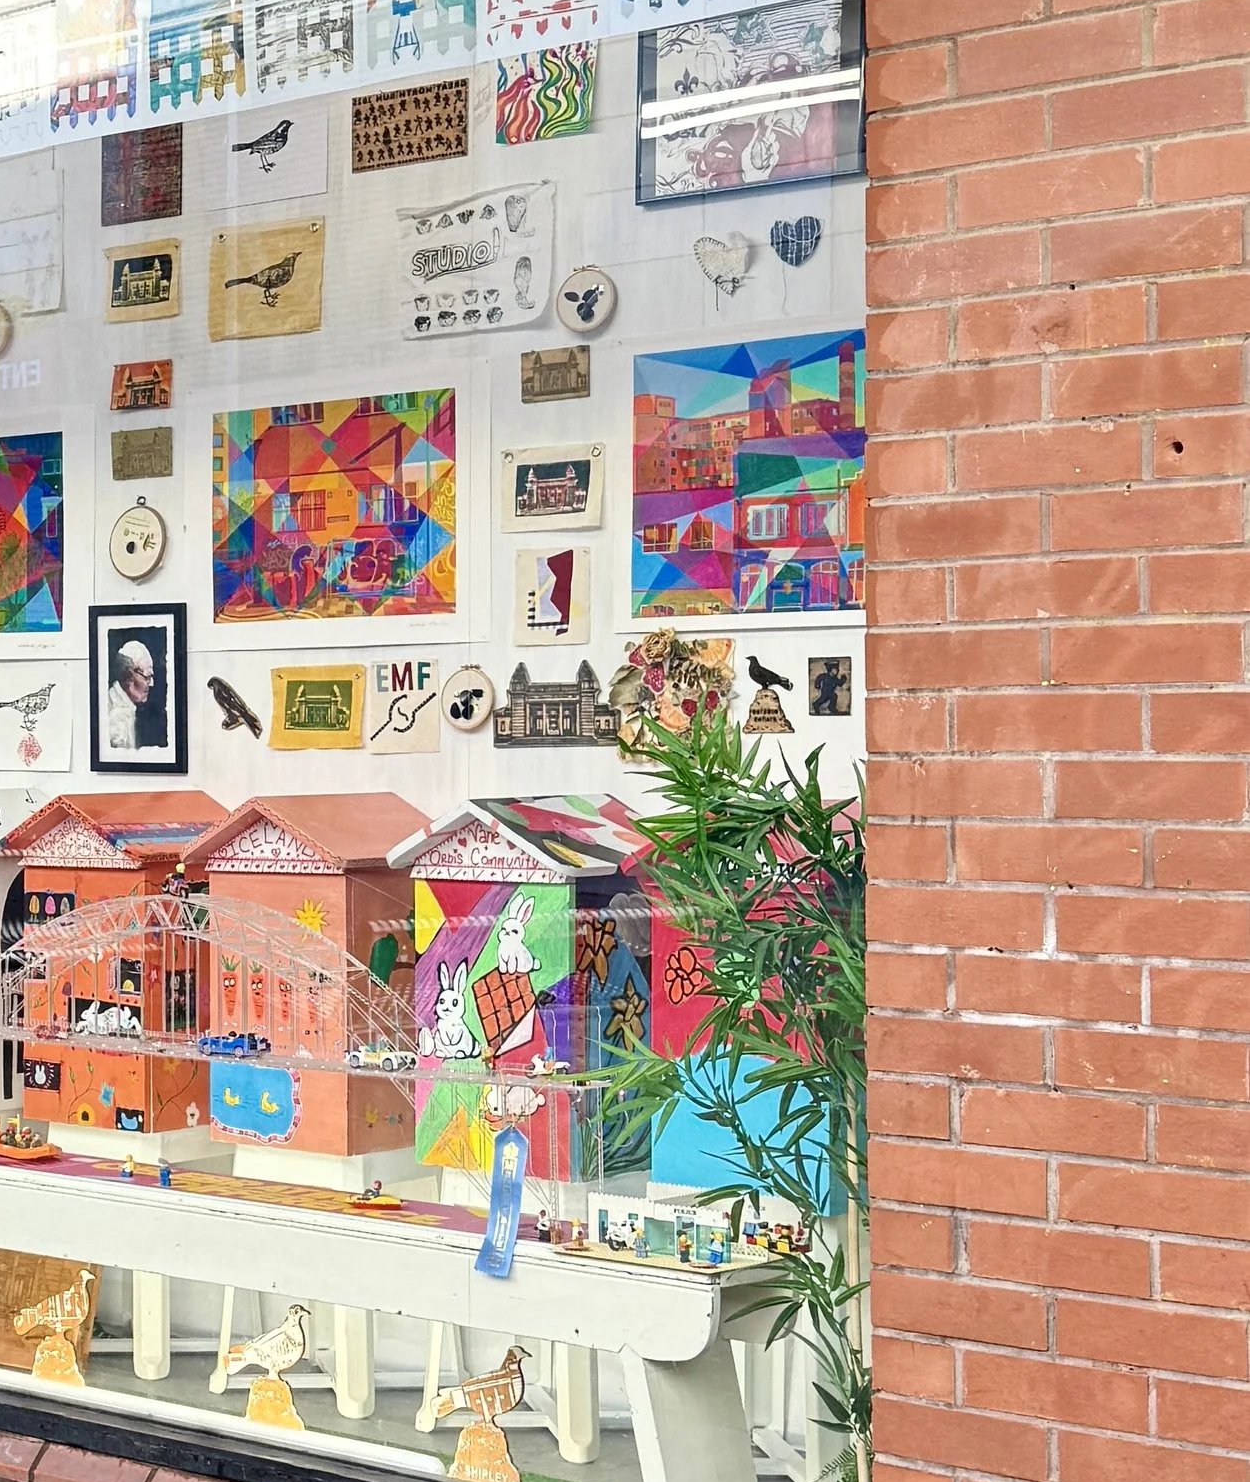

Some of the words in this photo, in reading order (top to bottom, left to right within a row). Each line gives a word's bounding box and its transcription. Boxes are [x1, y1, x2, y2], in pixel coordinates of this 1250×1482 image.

[412, 240, 492, 277] STUDIO
[375, 661, 432, 693] EMF
[228, 824, 317, 858] ICELAND
[467, 821, 502, 845] Vane
